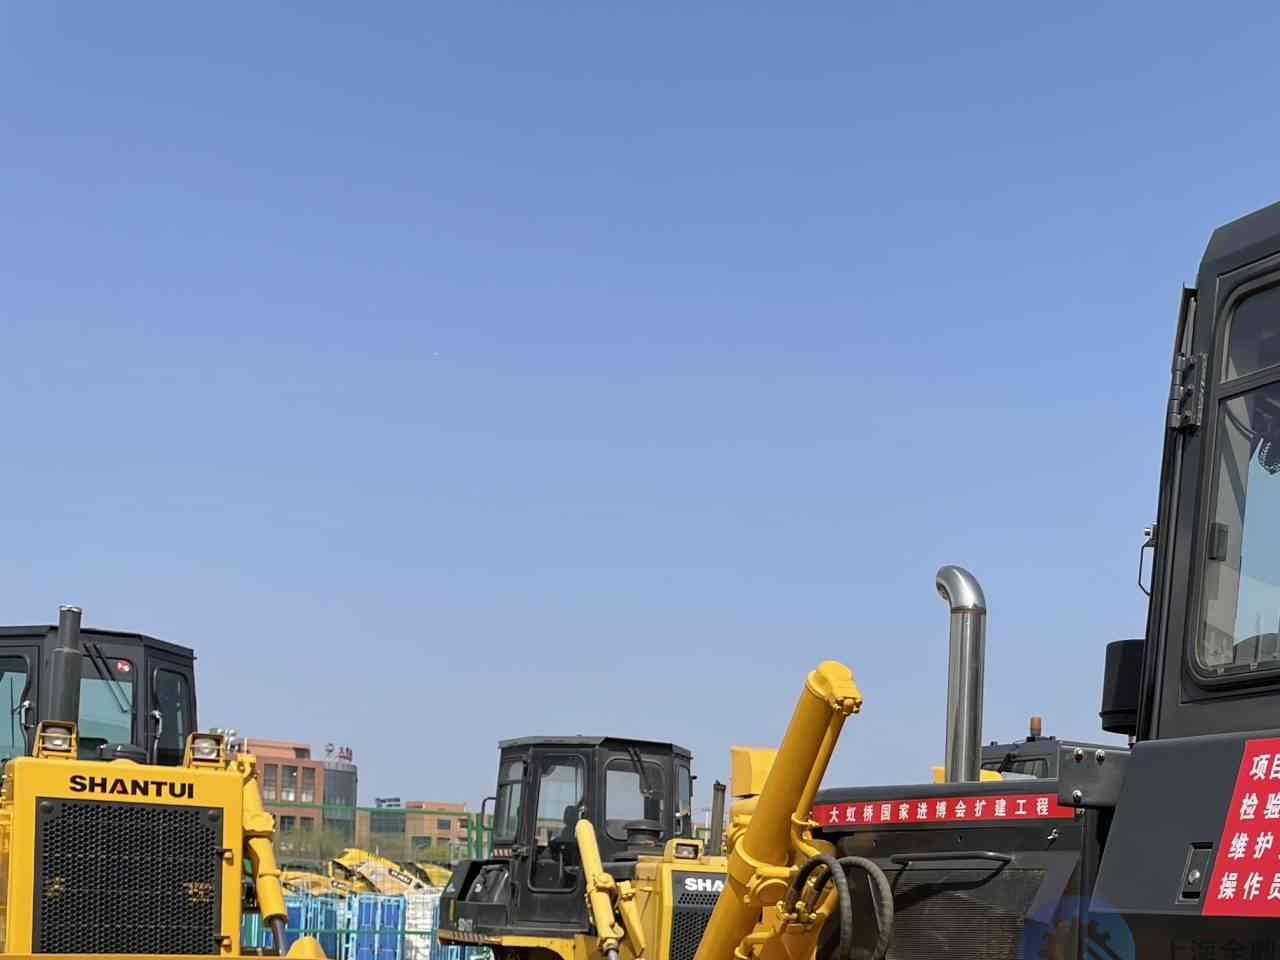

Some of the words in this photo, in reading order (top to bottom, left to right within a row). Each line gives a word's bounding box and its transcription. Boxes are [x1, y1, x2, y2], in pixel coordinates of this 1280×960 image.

[69, 775, 194, 799] SHANTUI
[829, 797, 1049, 823] 大虹桥国家进博会扩建工程
